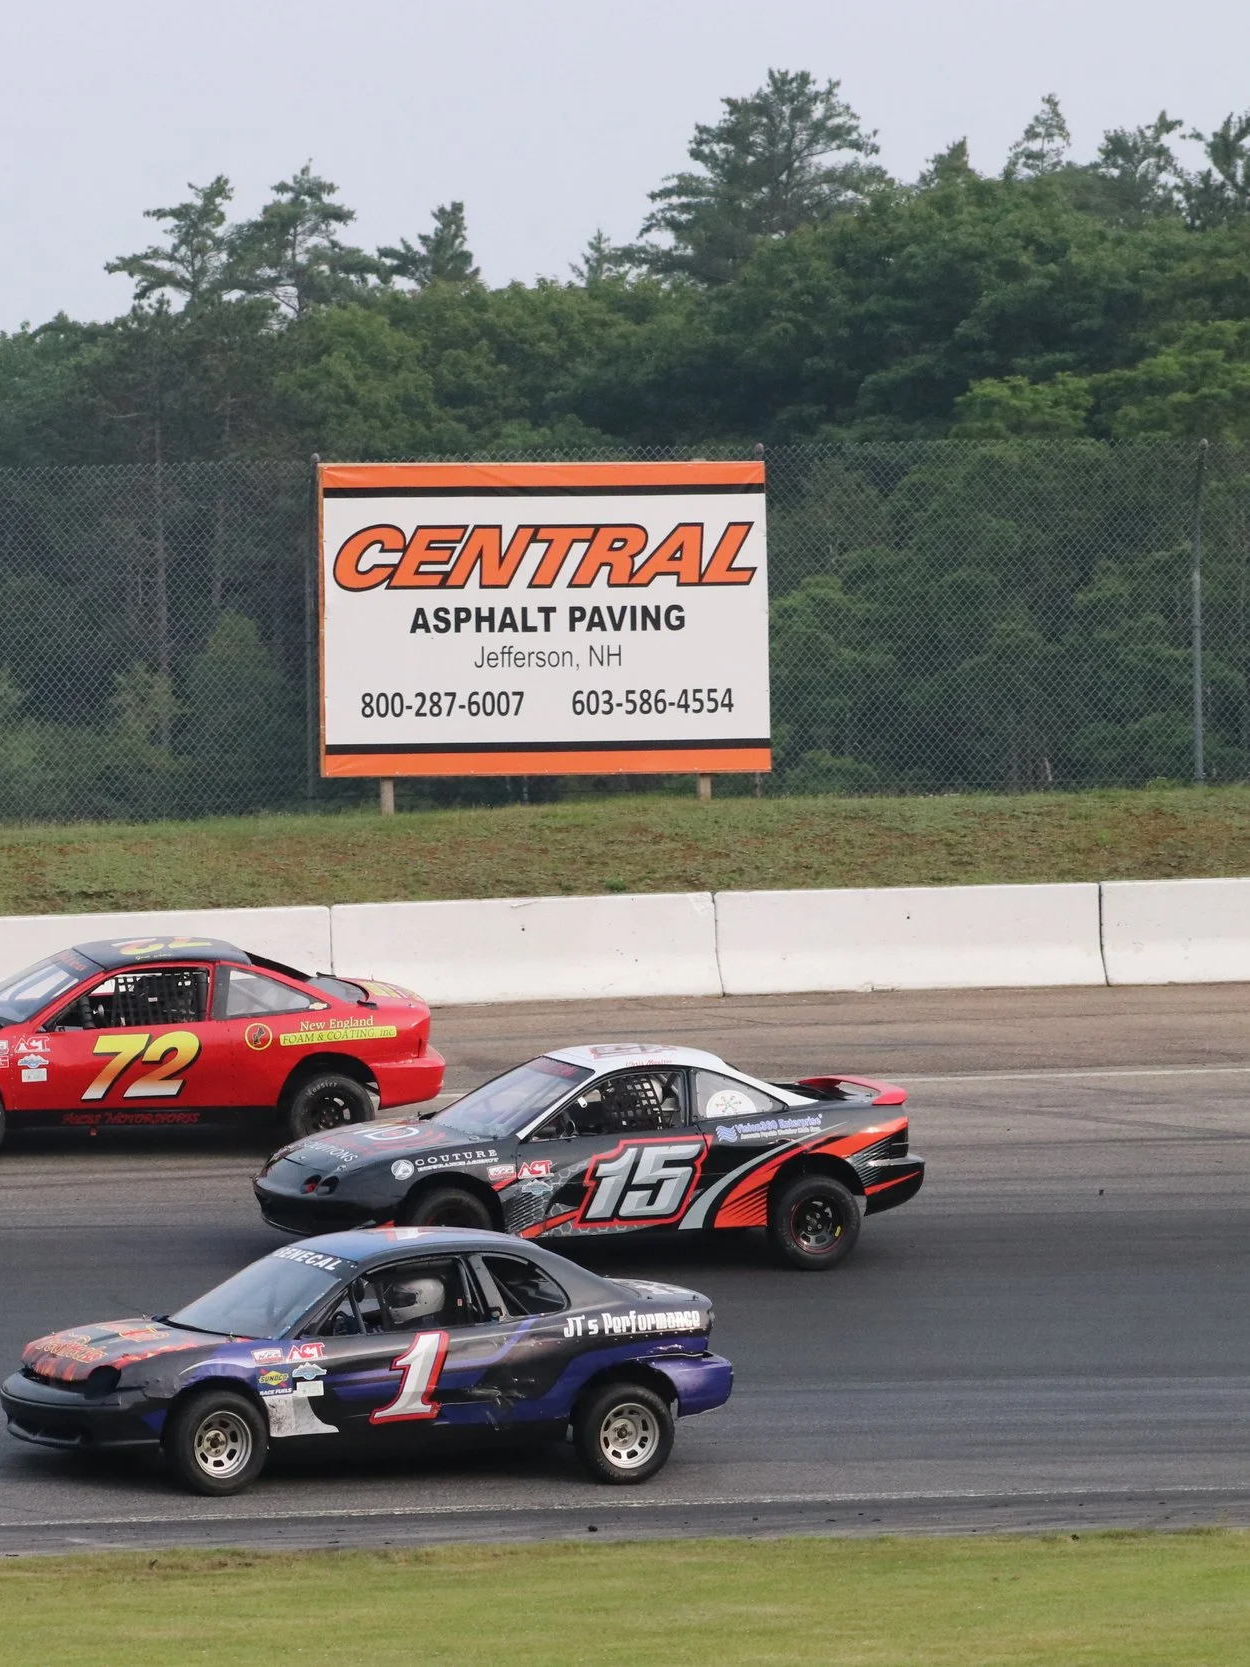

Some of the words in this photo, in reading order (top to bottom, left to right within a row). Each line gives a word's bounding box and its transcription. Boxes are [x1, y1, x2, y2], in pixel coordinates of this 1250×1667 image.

[333, 521, 758, 592] CENTRAL
[409, 606, 557, 634] ASPHALT
[568, 604, 686, 632] PAVING
[474, 645, 580, 671] Jefferson,
[589, 644, 622, 667] NH
[361, 691, 525, 719] 800-287-6007
[571, 687, 734, 716] 603-586-4554
[299, 1020, 326, 1032] New
[329, 1016, 374, 1030] England
[282, 1032, 315, 1045] FOAM
[81, 1030, 203, 1102] 72
[414, 1149, 498, 1167] COUTURE
[583, 1141, 704, 1221] 15
[272, 1246, 343, 1271] SENECAL
[601, 1310, 701, 1335] Performance
[260, 1373, 289, 1384] SUNOCO
[369, 1330, 451, 1425] 1
[259, 1388, 275, 1396] RACE
[275, 1387, 293, 1395] FUELS
